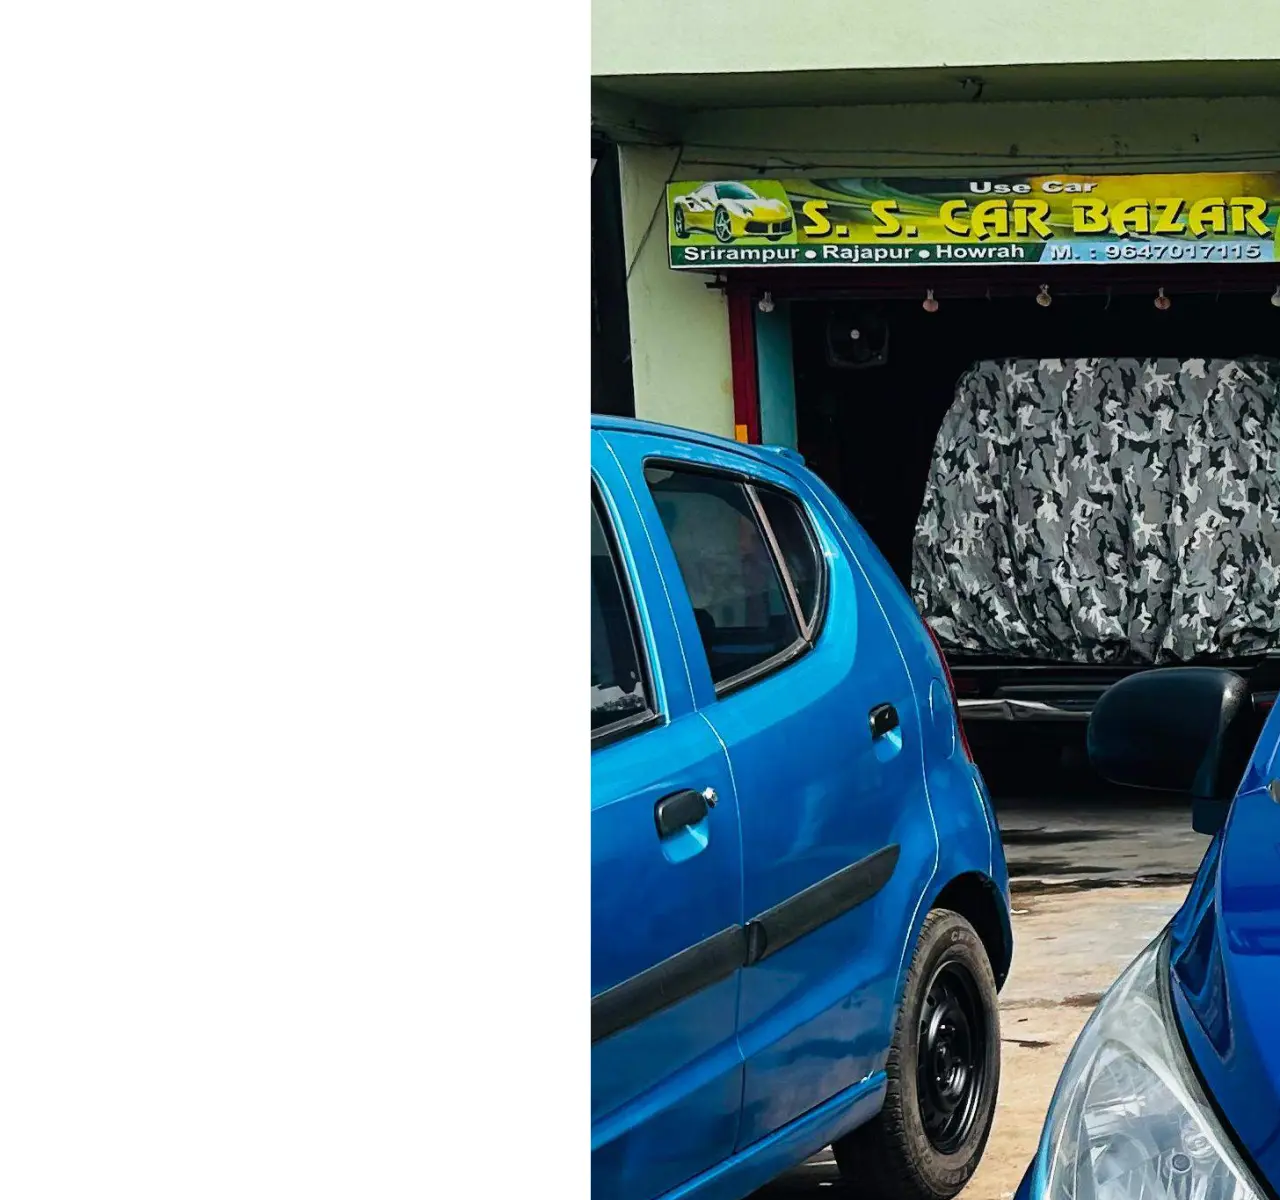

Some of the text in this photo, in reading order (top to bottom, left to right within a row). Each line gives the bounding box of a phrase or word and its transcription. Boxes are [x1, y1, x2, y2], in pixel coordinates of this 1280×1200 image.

[969, 180, 1098, 194] Use Car
[802, 196, 1272, 241] S. S. CAR BAZAR
[684, 244, 1025, 265] Srirampur Rajapur Howrah
[1106, 244, 1262, 260] 9647017115
